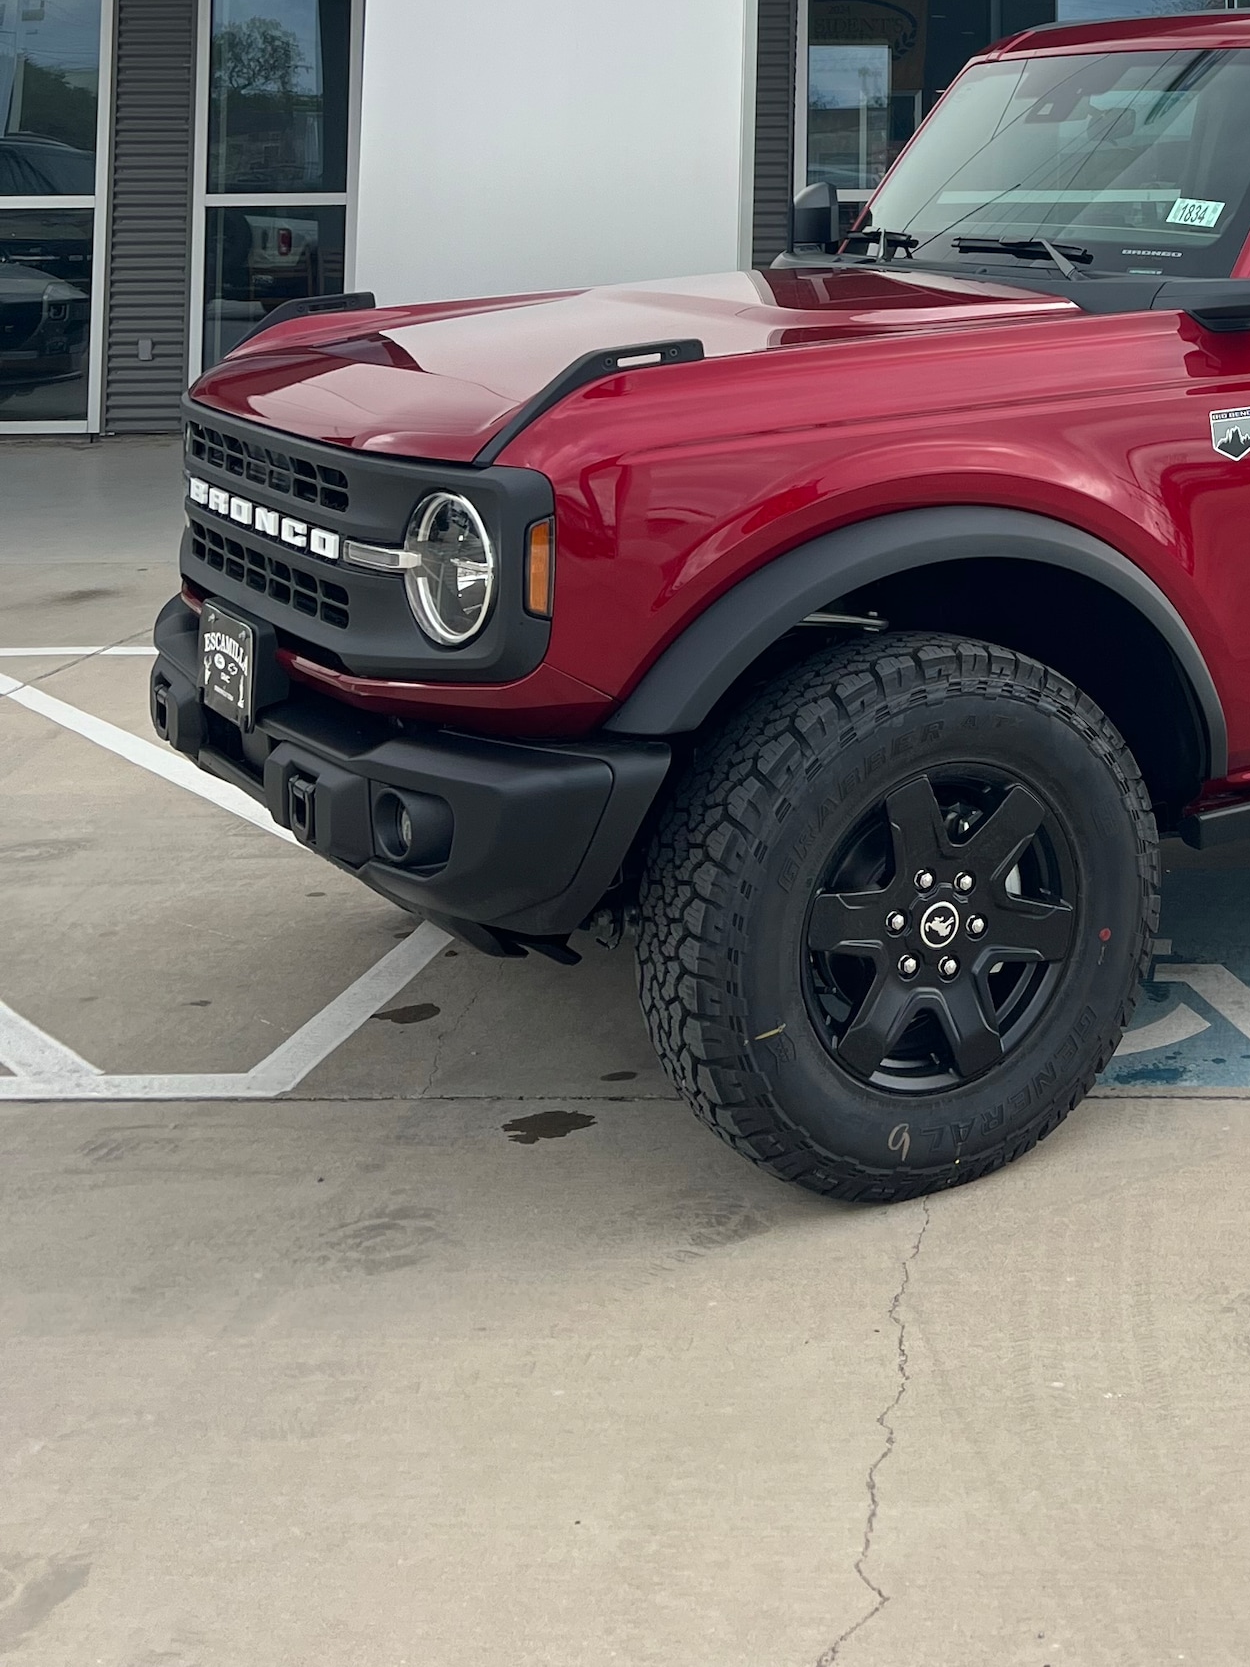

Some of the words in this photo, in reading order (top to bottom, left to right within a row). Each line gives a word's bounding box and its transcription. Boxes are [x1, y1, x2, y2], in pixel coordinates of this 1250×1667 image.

[813, 17, 905, 35] SIDENT'S
[1178, 202, 1210, 224] 1834
[1121, 248, 1183, 258] BRONCO
[189, 477, 339, 559] BRONCO
[204, 632, 248, 675] ESCAMILLA
[777, 720, 944, 894] GRABBER
[919, 1005, 1098, 1156] GENERAL
